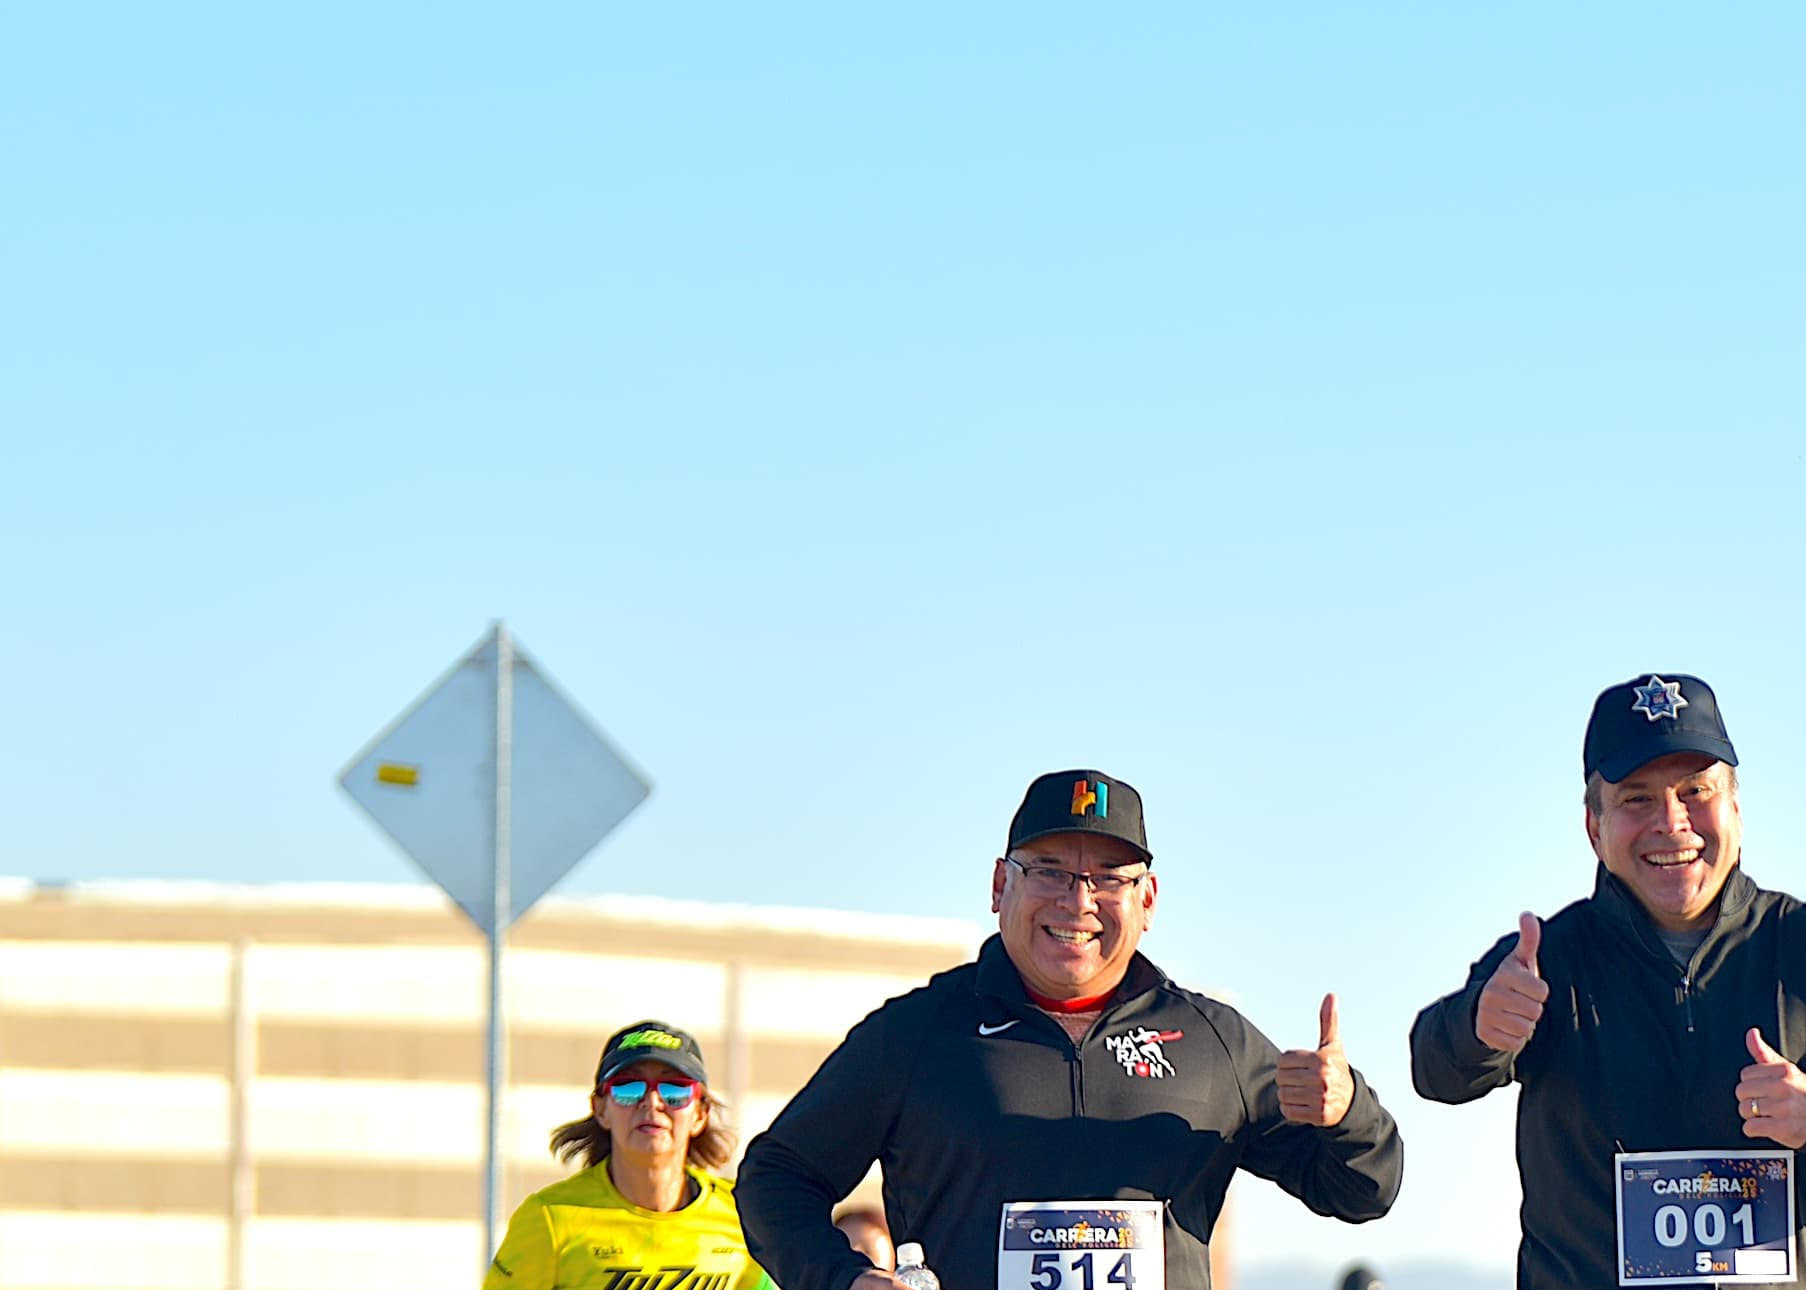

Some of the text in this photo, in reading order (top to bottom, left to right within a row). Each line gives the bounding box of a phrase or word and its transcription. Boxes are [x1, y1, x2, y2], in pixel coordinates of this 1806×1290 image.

[1105, 1035, 1136, 1052] MA
[1116, 1049, 1143, 1064] RA
[1653, 1177, 1742, 1195] CARRERA
[1654, 1203, 1755, 1247] 001
[1030, 1227, 1119, 1244] CARRERA
